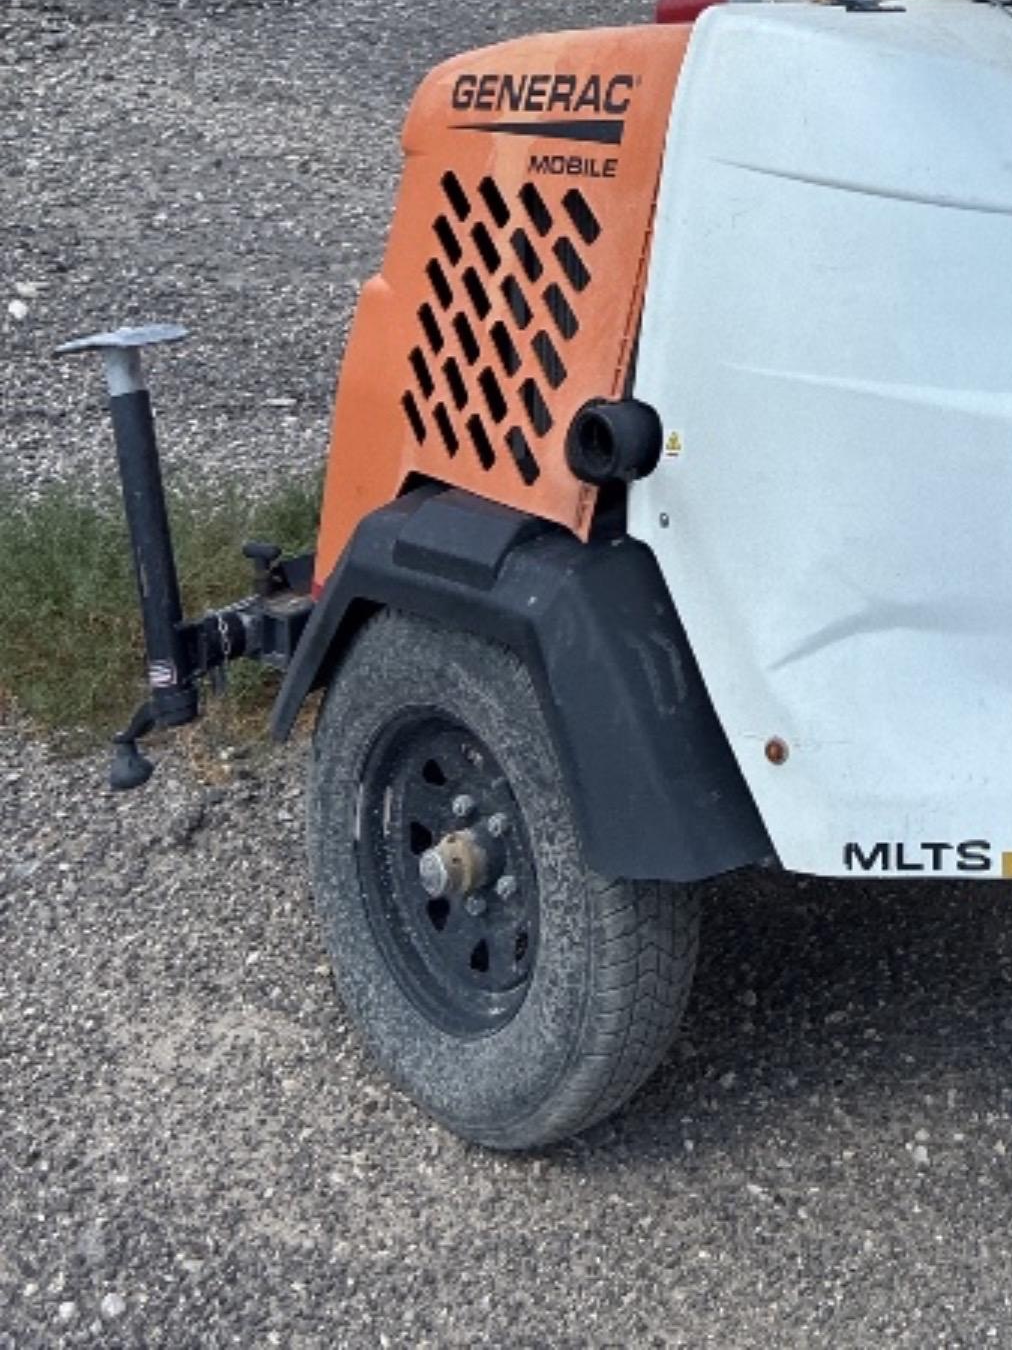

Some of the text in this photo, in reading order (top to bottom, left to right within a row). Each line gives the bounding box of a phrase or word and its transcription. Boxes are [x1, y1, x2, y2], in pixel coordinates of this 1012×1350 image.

[452, 74, 633, 113] GENERAC
[528, 155, 618, 178] MOBILE
[843, 840, 991, 871] MLTS
